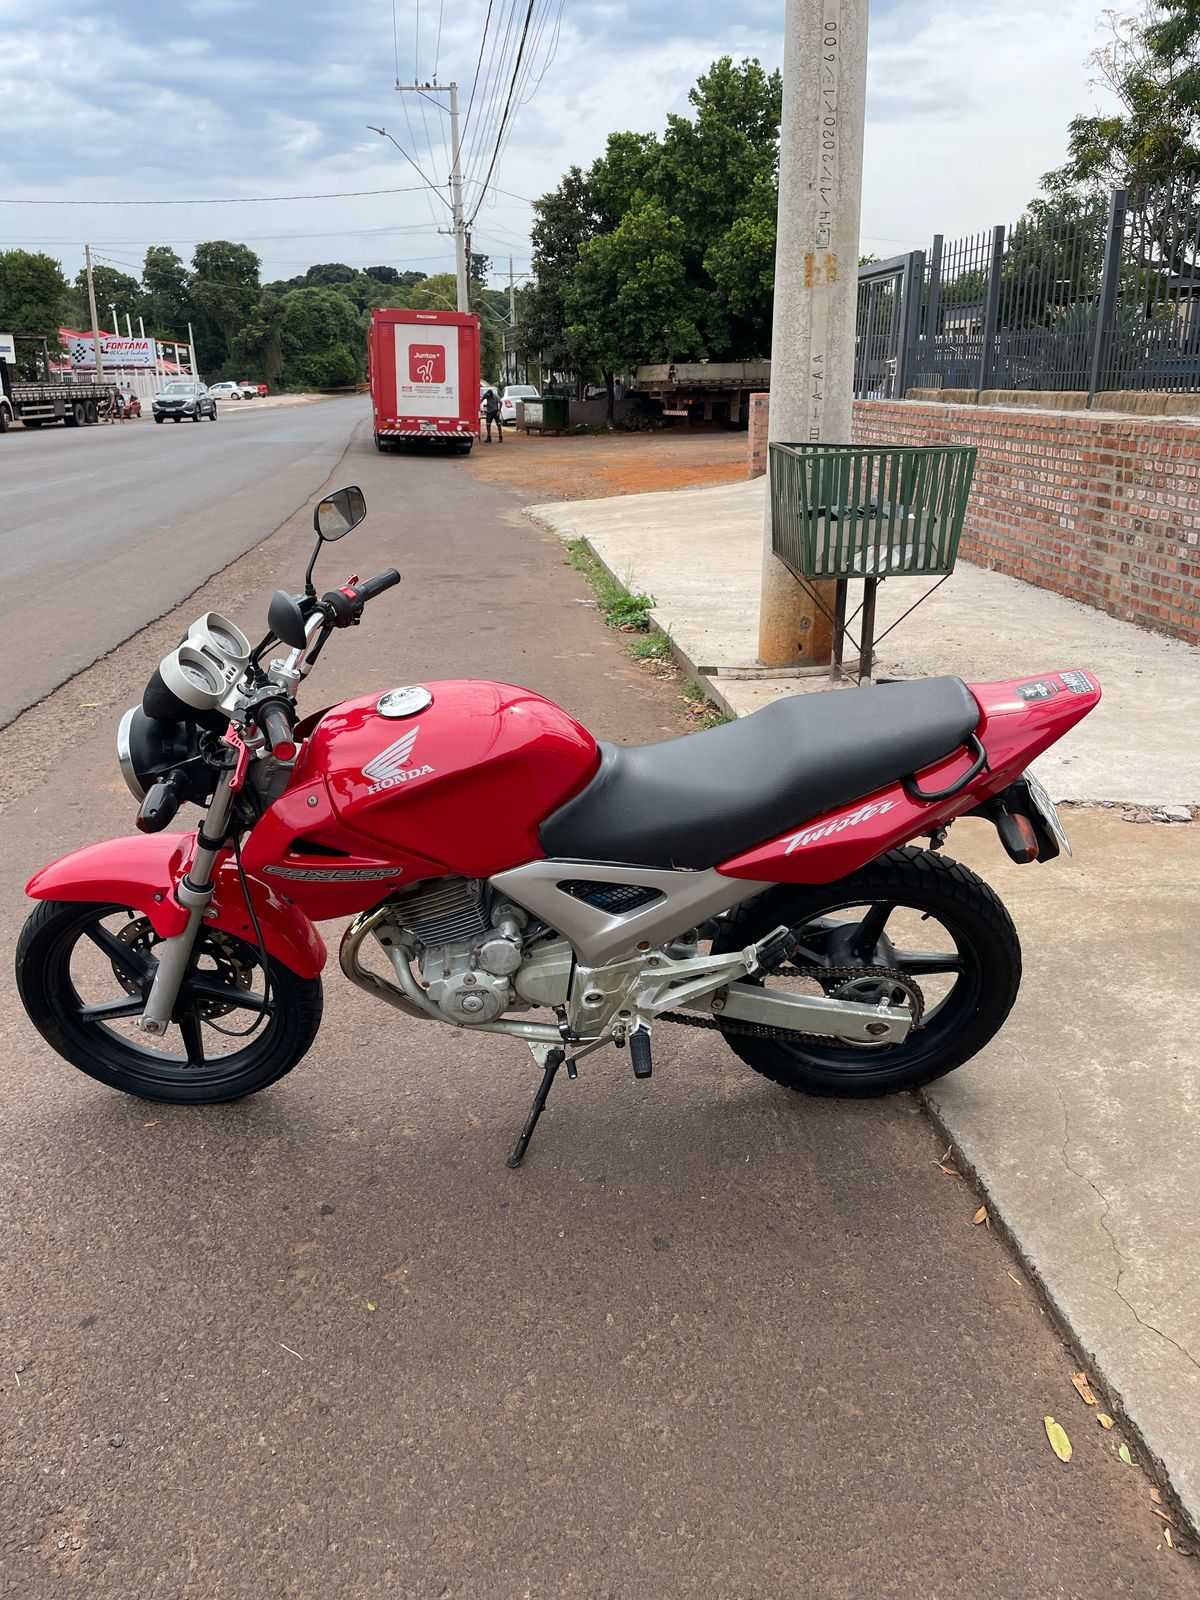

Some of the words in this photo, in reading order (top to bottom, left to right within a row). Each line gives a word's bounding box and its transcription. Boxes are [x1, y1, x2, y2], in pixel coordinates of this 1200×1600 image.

[105, 341, 150, 350] FONTANA
[367, 764, 436, 795] HONDA
[777, 799, 897, 857] Twister
